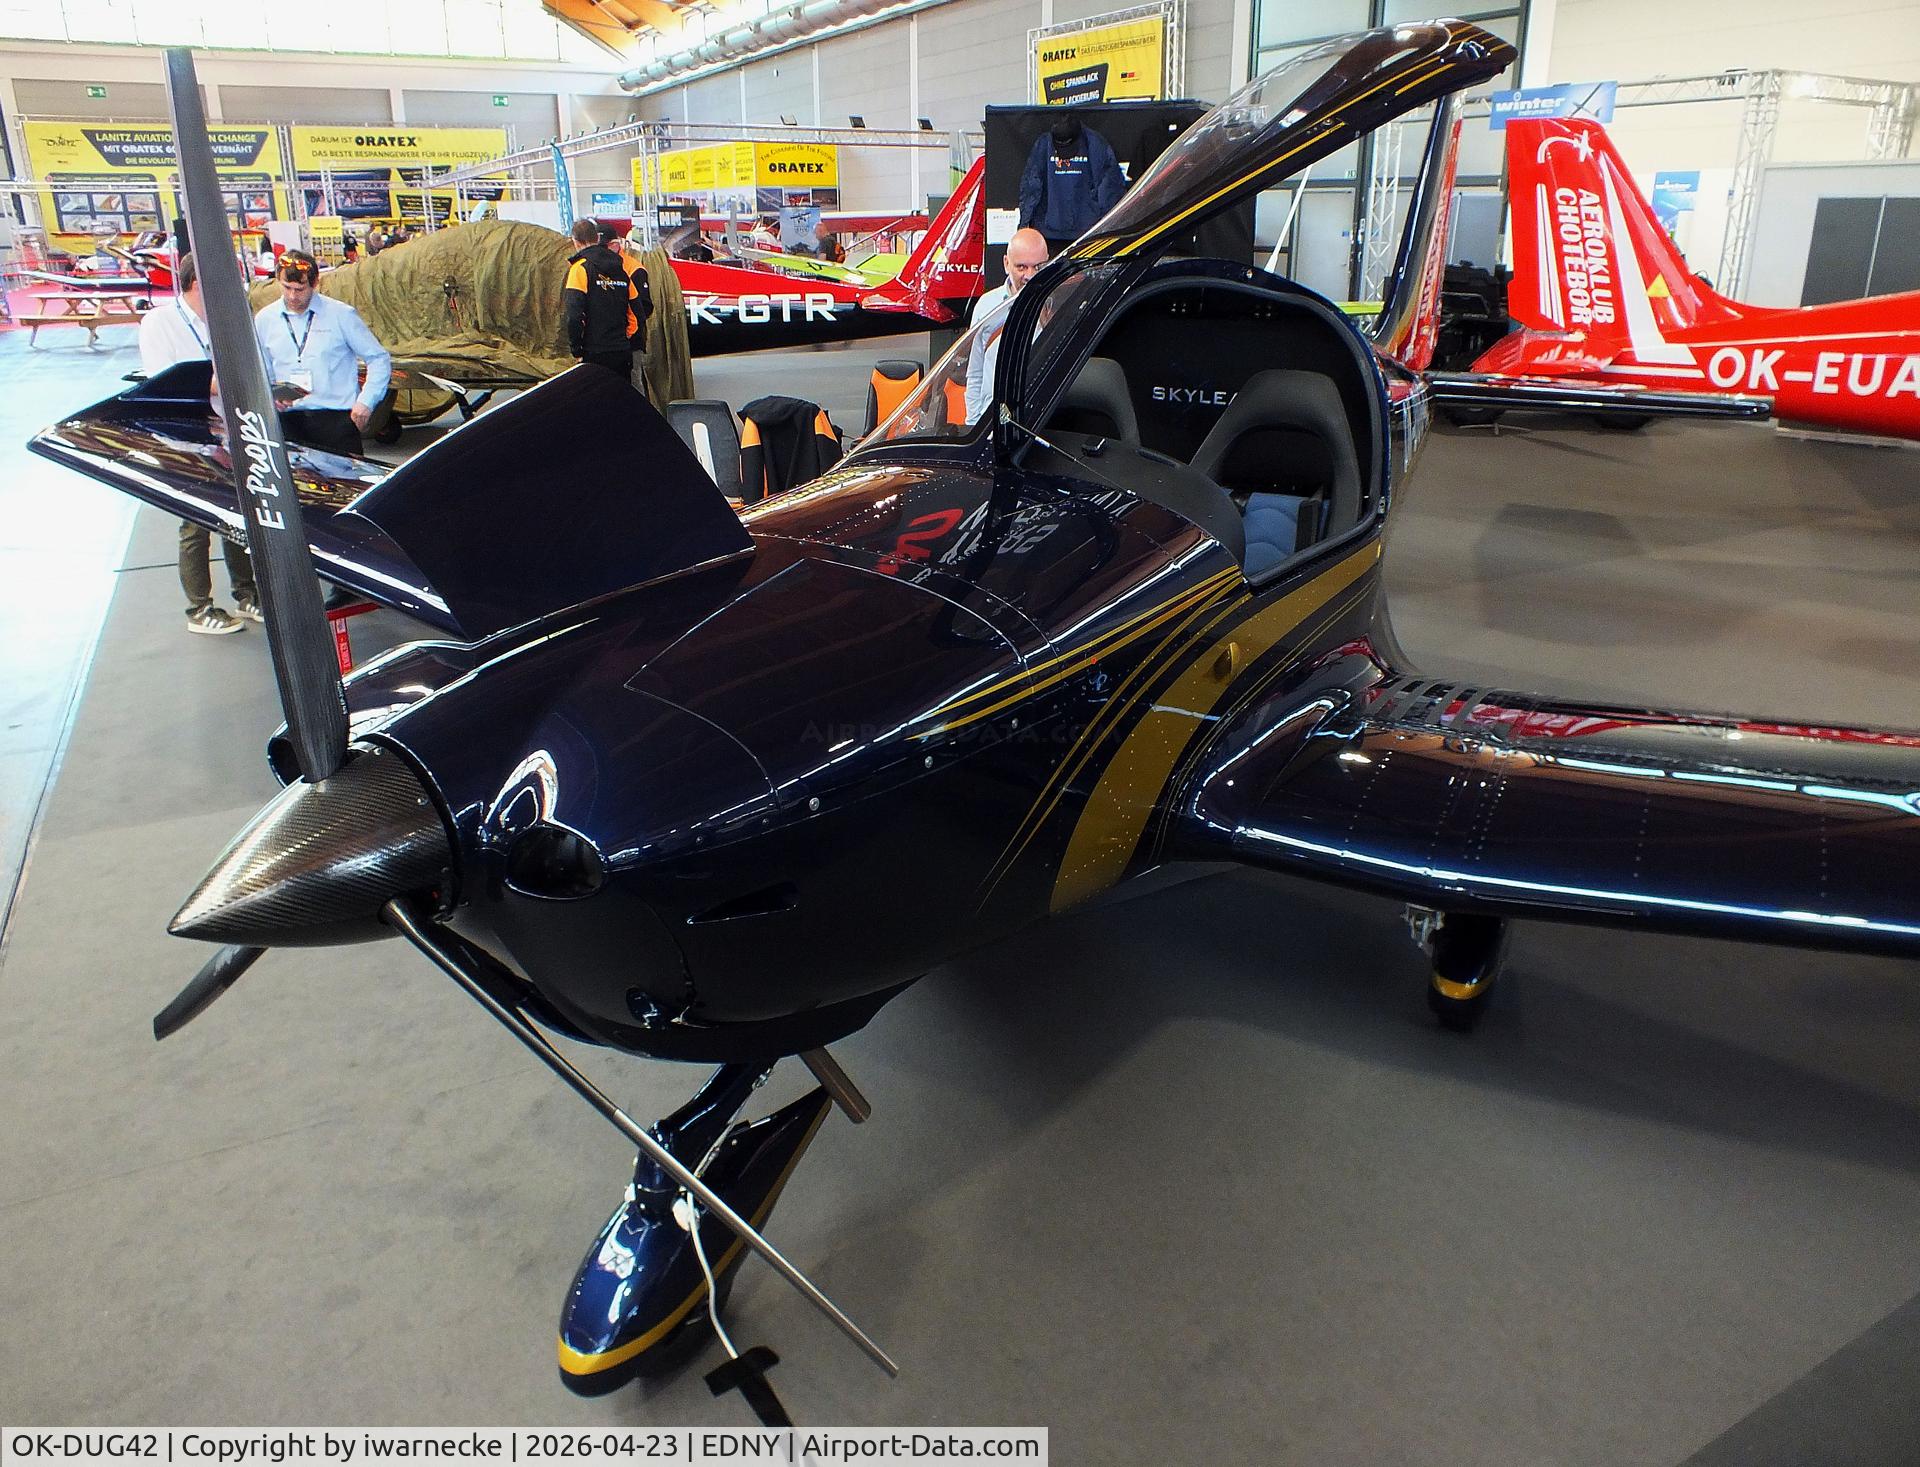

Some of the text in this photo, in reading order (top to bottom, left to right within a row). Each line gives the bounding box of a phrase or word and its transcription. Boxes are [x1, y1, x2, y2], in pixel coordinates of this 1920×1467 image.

[1042, 48, 1076, 62] ORATEX
[1050, 72, 1099, 90] OHNE SPANNLACK
[1496, 91, 1566, 112] winter
[95, 133, 131, 142] LANITZ
[134, 134, 172, 142] AVIATIO
[218, 134, 257, 143] CHANGE
[355, 136, 417, 146] ORATEX
[103, 145, 120, 153] MIT
[121, 145, 163, 153] ORATEX
[211, 144, 254, 153] VERNÄHT
[769, 163, 824, 173] ORATEX
[1578, 188, 1615, 324] AEROKLUB
[689, 293, 837, 325] K-GTR
[1152, 386, 1238, 405] SKYLE
